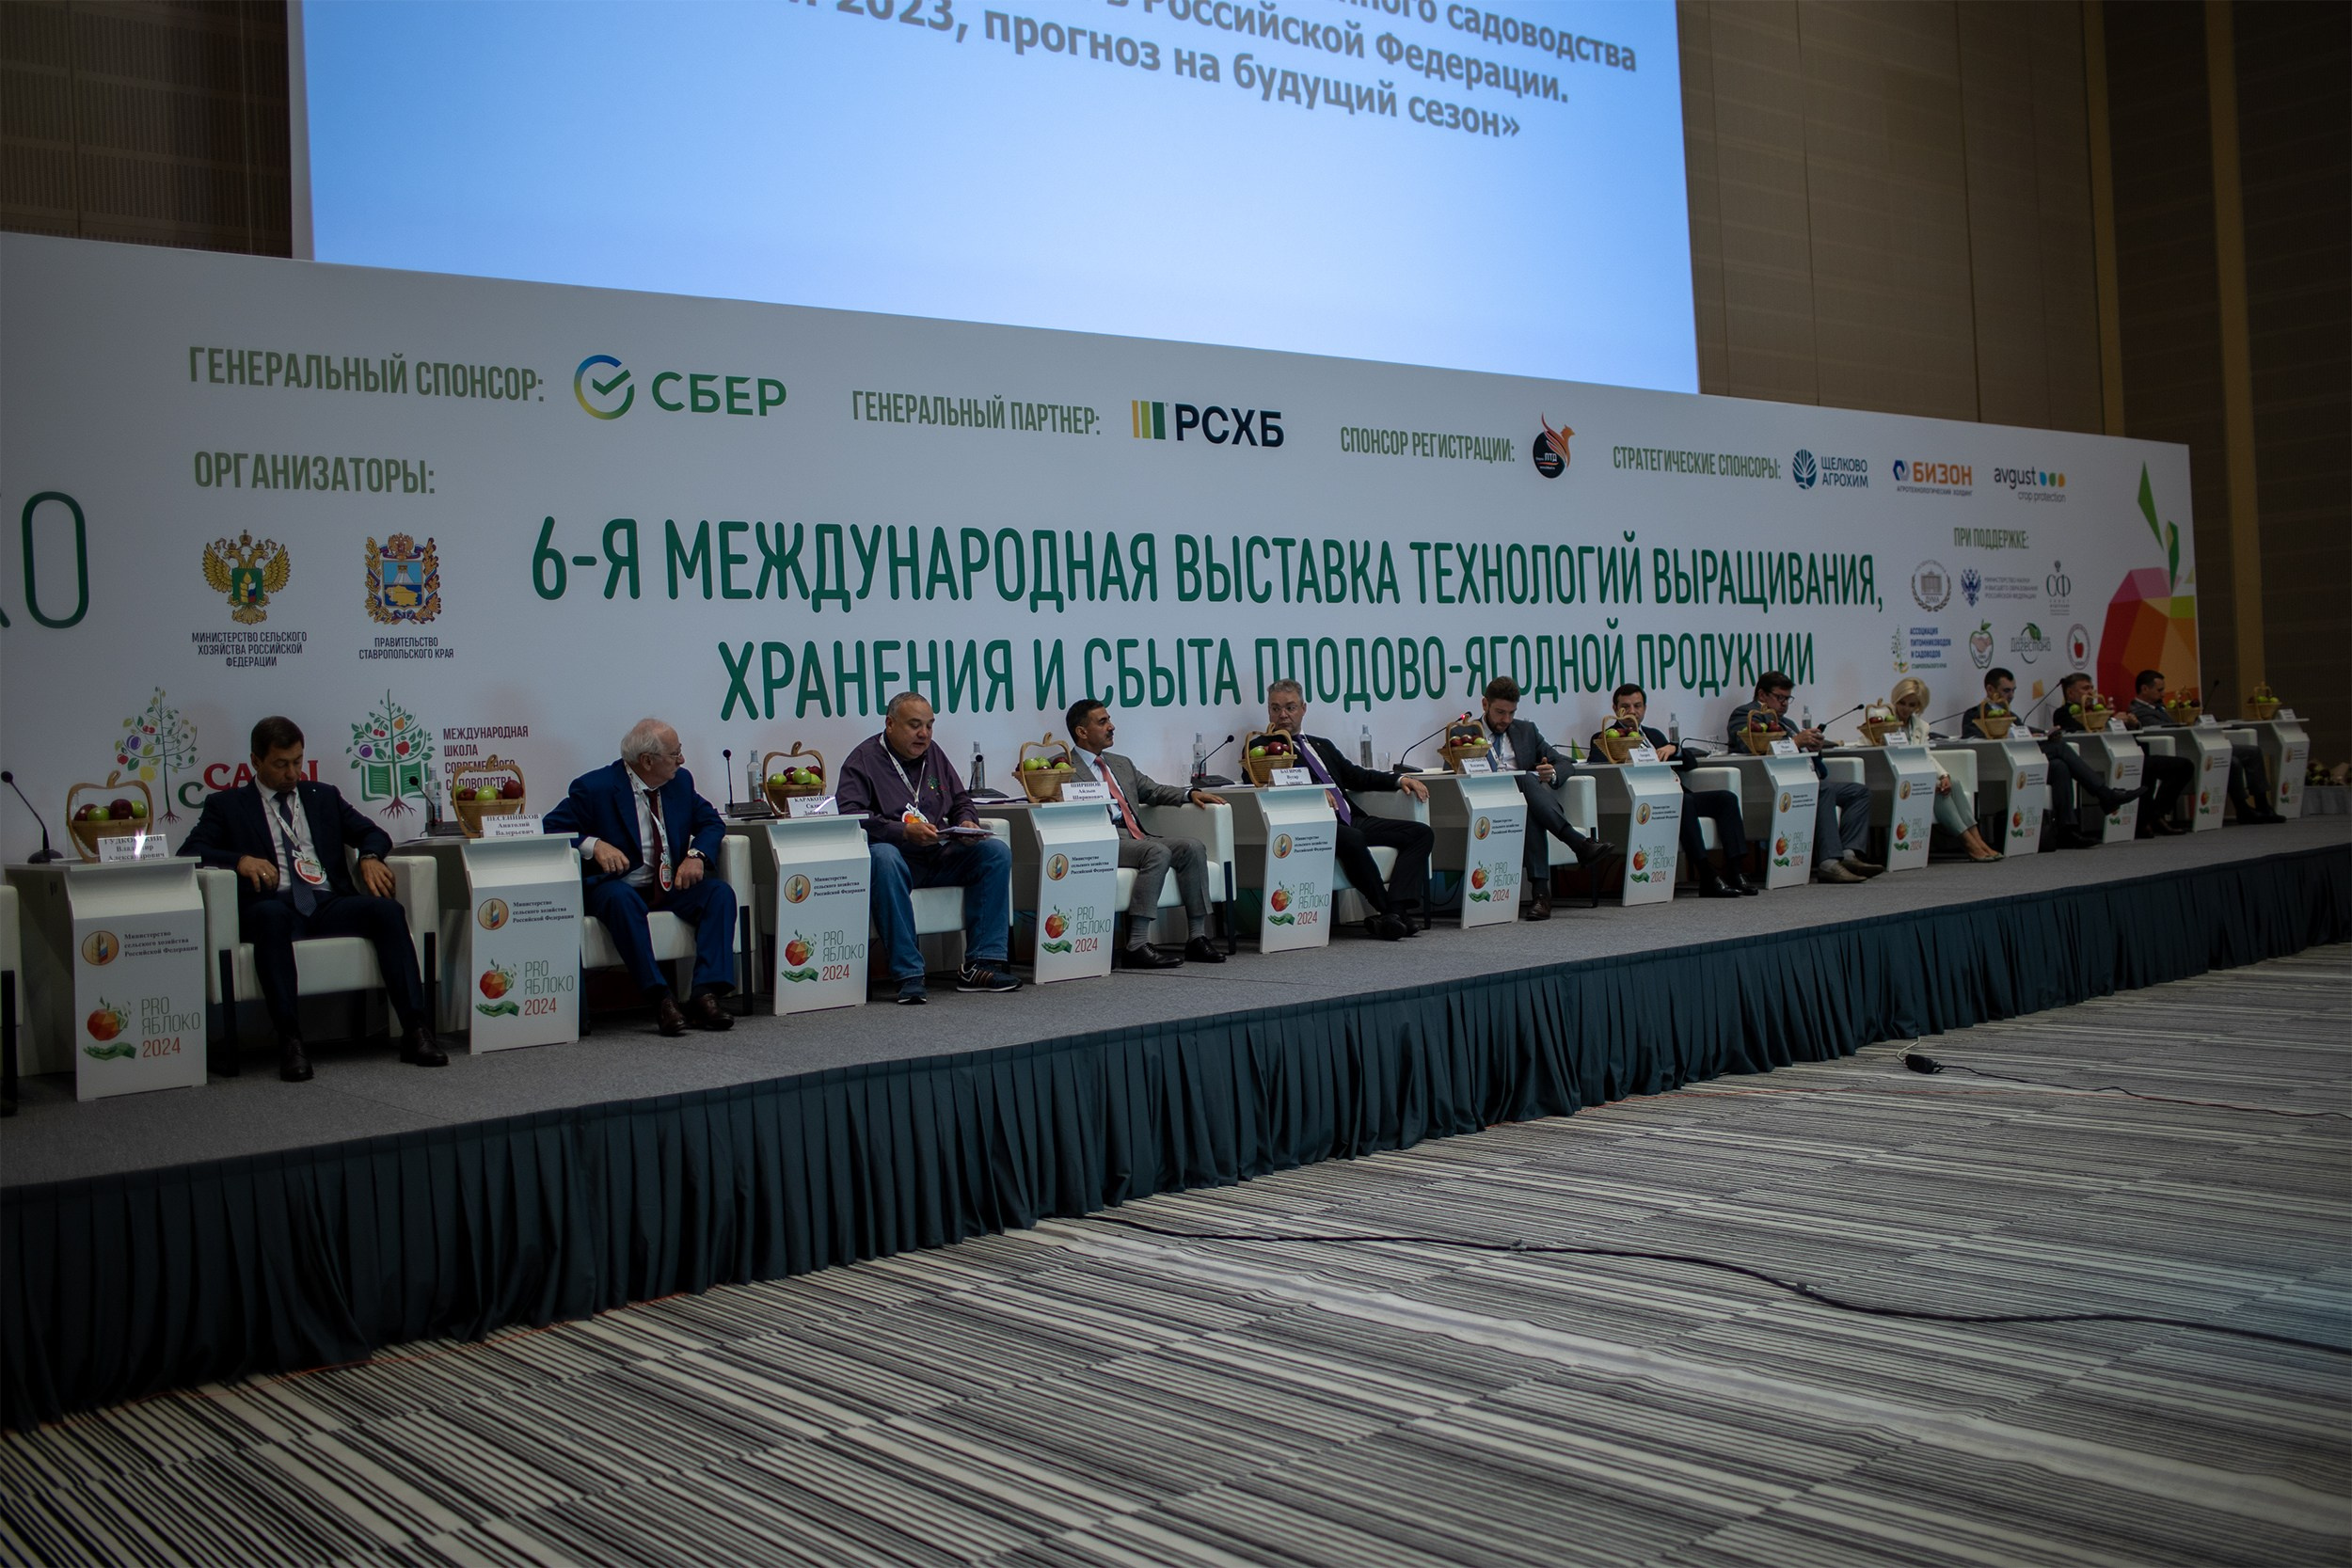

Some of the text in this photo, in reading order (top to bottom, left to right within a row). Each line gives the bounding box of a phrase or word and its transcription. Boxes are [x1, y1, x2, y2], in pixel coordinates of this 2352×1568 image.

[1447, 3, 1638, 72] садоводства
[985, 9, 1161, 72] прогноз
[1175, 47, 1221, 84] на
[1233, 53, 1397, 118] будущий
[1407, 95, 1521, 138] сезон»
[1375, 31, 1569, 103] Федерации.
[189, 346, 545, 403] ГЕНЕРАЛЬНЫЙ СПОНСОР:
[652, 372, 787, 417] СБЕР
[852, 390, 1101, 436] ГЕНЕРАЛЬНЫЙ ПАРТНЕР:
[1175, 403, 1285, 449] РСХБ
[1342, 426, 1515, 465] СПОНСОР РЕГИСТРАЦИИ:
[1613, 446, 1782, 481] СТРАТЕГИЧЕСКИЕ СПОНСОРЫ:
[1820, 456, 1867, 474] ЩЕЛКОВО
[194, 451, 436, 495] ОРГАНИЗАТОРЫ:
[1821, 472, 1868, 489] АГРОХИМ
[1913, 461, 1973, 486] БИЗОН
[1994, 467, 2037, 490] avgust
[2035, 491, 2066, 505] protection
[1954, 527, 2029, 550] ПРИ ПОДДЕРЖКЕ:
[532, 517, 1883, 615] 6-Я МЕЖДУНАРОДНАЯ ВЫСТАВКА ТЕХНОЛОГИЙ ВЫРАЩИВАНИЯ,
[191, 631, 309, 646] МИНИСТЕРСТВО СЕЛЬСКОГО
[374, 637, 438, 648] ПРАВИТЕЛЬСТВО
[198, 642, 304, 657] ХОЗЯЙСТВА РОССИЙСКОЙ
[358, 648, 454, 659] СТАВРОПОЛЬСКОГО КРАЯ
[226, 656, 278, 669] ФЕДЕРАЦИИ
[719, 640, 1014, 721] ХРАНЕНИЯ
[1033, 640, 1066, 711] И
[1084, 637, 1243, 709] СБЫТА
[1636, 631, 1816, 699] ПРОДУКЦИИ
[443, 725, 530, 740] МЕЖДУНАРОДНАЯ
[444, 744, 479, 757] ШКОЛА
[1298, 881, 1315, 895] PRO
[1492, 889, 1510, 902] 2024
[1297, 894, 1329, 910] ЯБЛОКО
[1075, 905, 1095, 921] PRO
[1297, 911, 1318, 926] 2024
[124, 931, 171, 941] Министерство
[1075, 918, 1112, 936] ЯБЛОКО
[124, 939, 189, 949] сельского хозяйства
[823, 929, 844, 946] PRO
[1074, 937, 1098, 953] 2024
[124, 945, 199, 958] Российской Федерации
[822, 943, 866, 964] ЯБЛОКО
[524, 959, 549, 978] PRO
[822, 964, 850, 981] 2024
[524, 974, 575, 995] ЯБЛОКО
[141, 997, 170, 1017] PRO
[524, 996, 557, 1016] 2024
[141, 1012, 201, 1036] ЯБЛОКО
[143, 1037, 182, 1058] 2024
